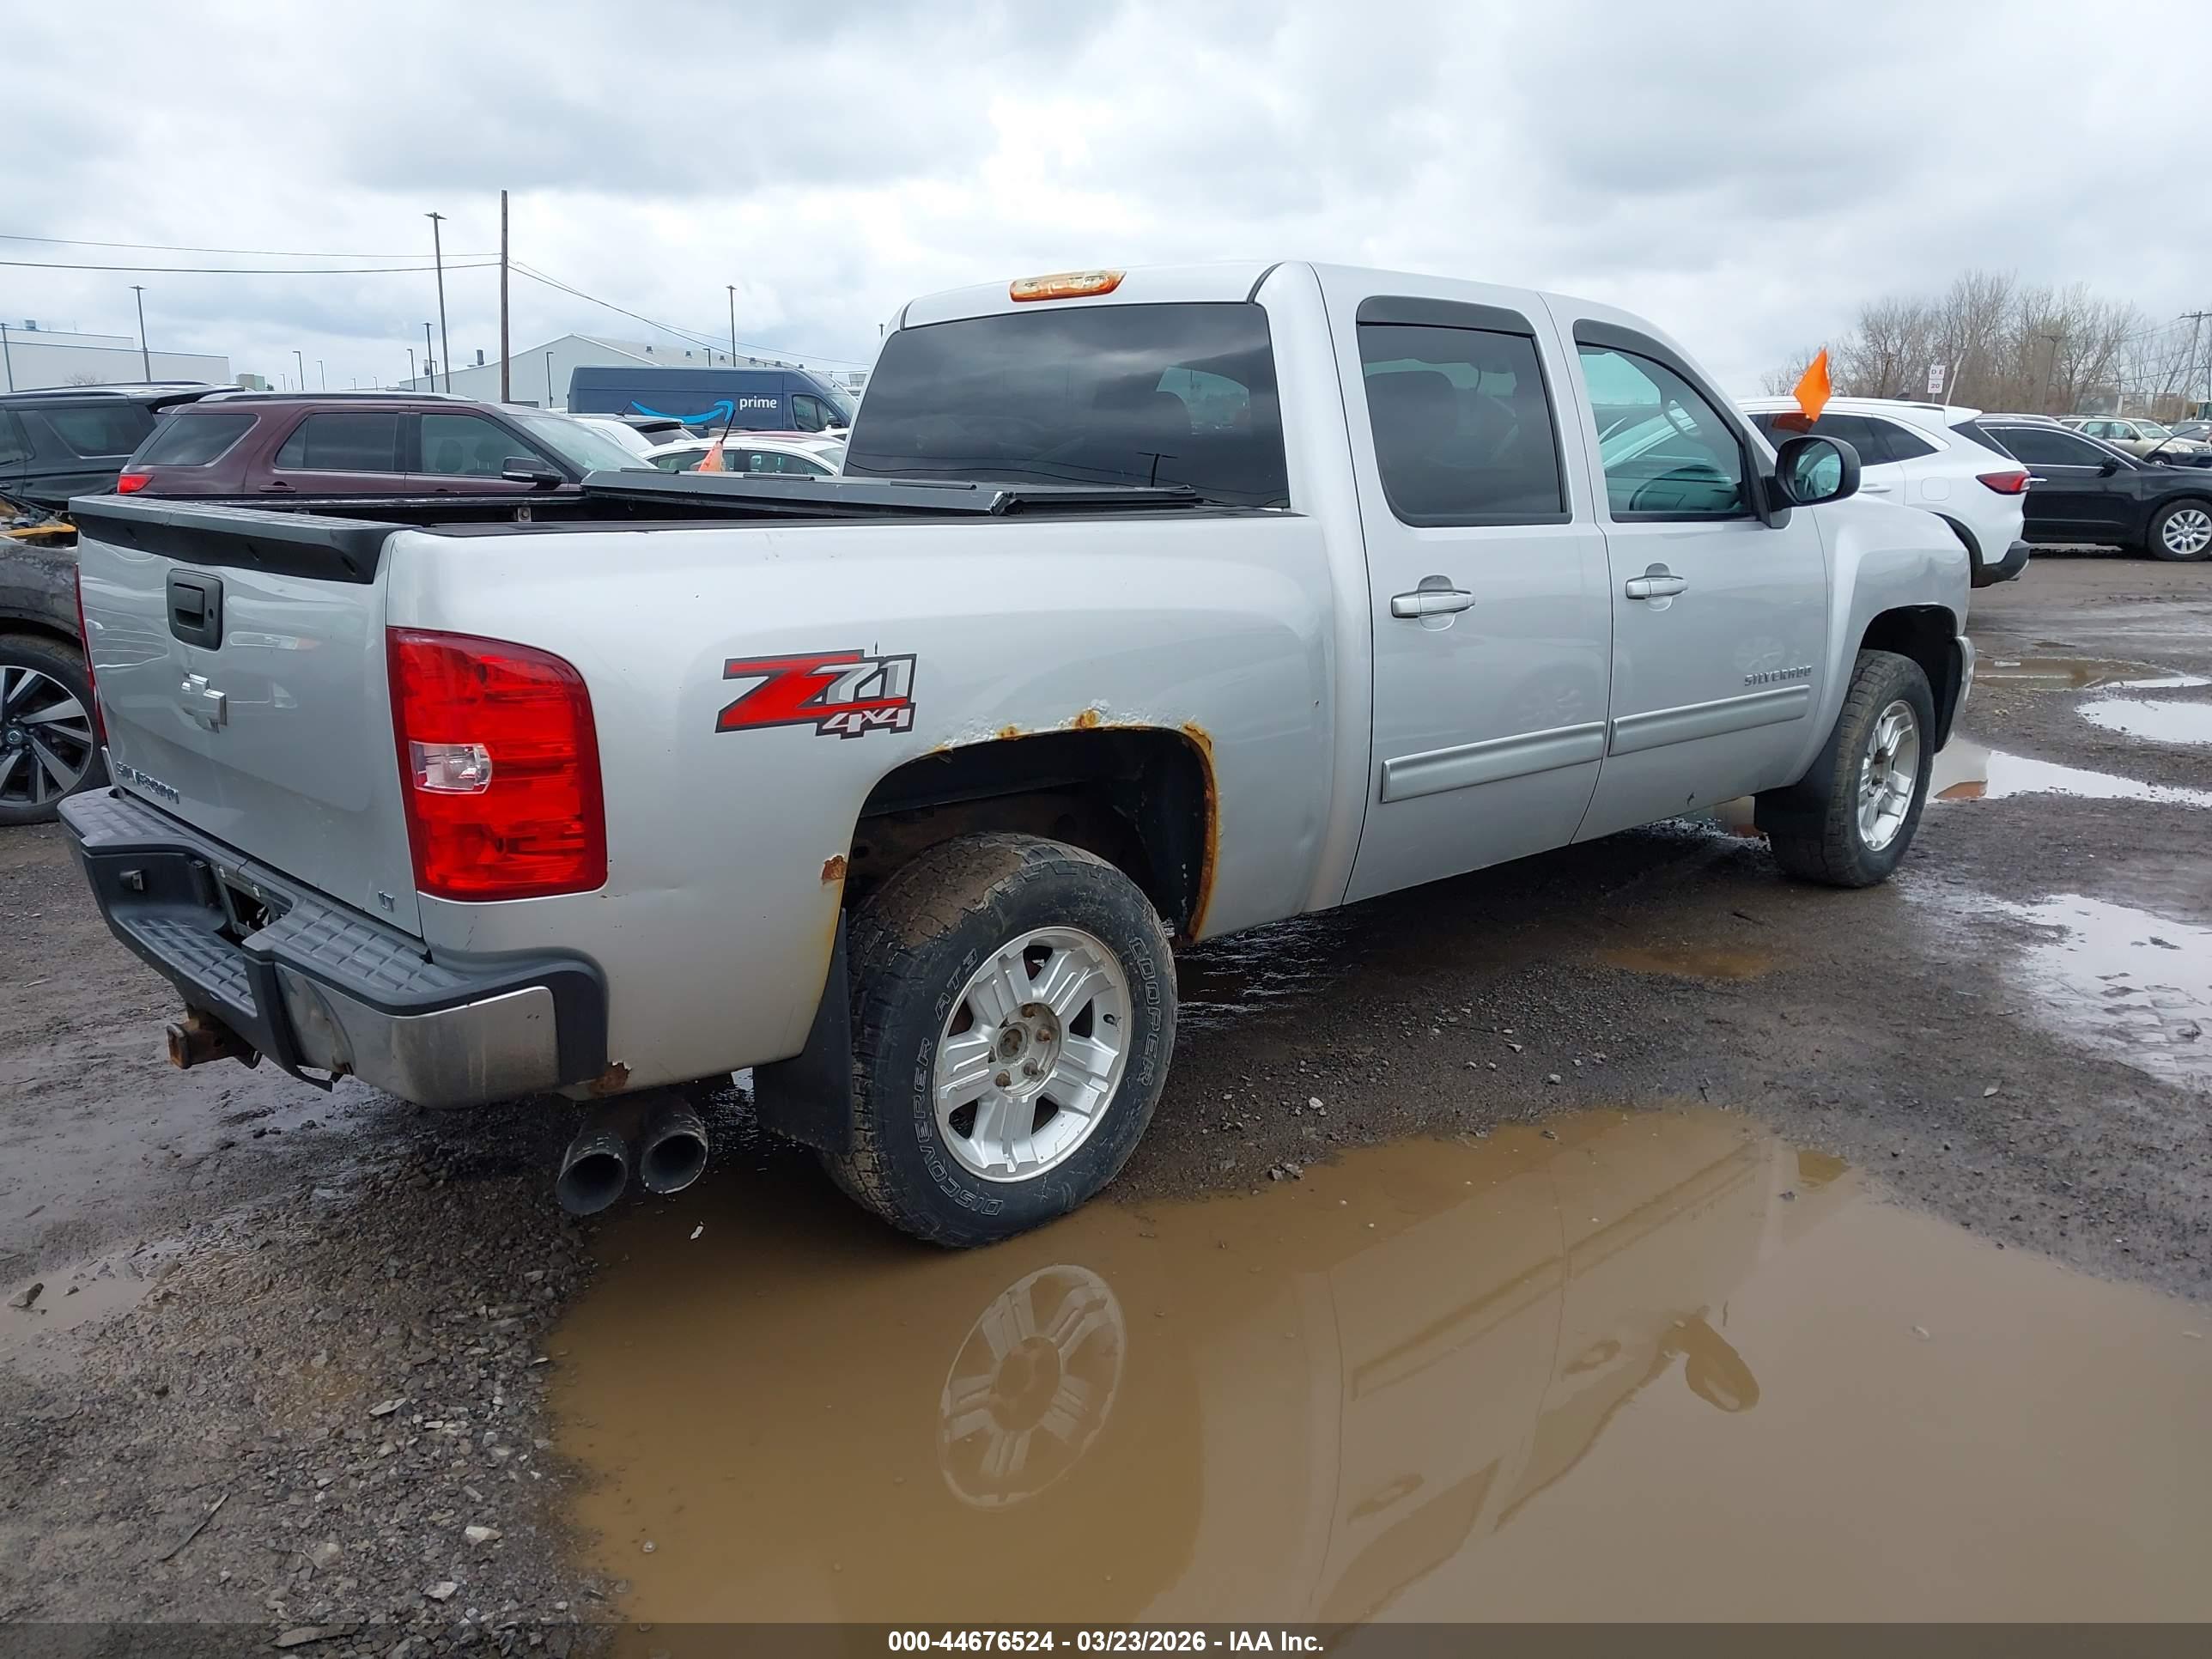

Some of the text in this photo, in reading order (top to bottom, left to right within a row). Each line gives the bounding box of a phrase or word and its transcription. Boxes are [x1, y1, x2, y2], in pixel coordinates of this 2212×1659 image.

[739, 395, 777, 410] prime
[714, 649, 917, 733] Z71
[378, 890, 395, 913] LT
[1126, 936, 1161, 1087] COOPER
[912, 1036, 1004, 1216] DISCOVERER
